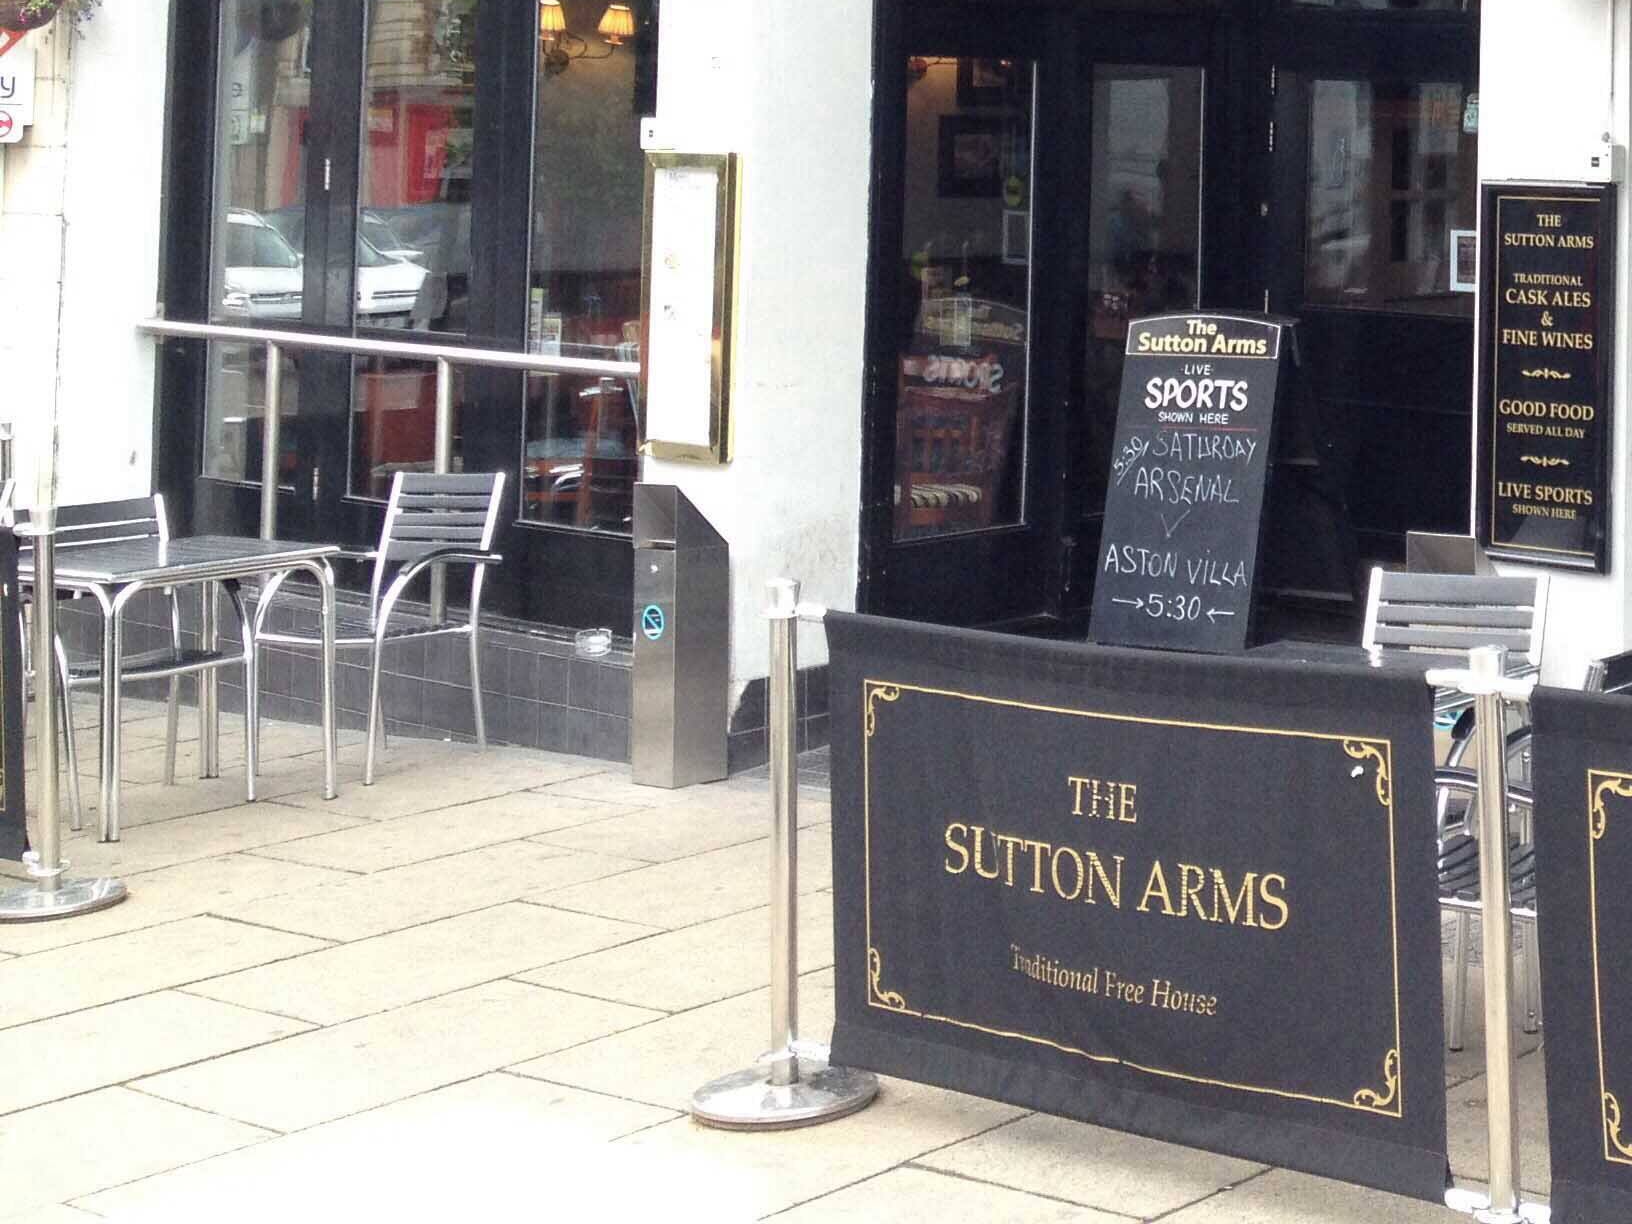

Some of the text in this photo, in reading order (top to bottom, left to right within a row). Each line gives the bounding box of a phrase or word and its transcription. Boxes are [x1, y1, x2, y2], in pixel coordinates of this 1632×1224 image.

[1536, 214, 1562, 227] THE
[1504, 233, 1594, 249] SUTTON ARMS
[1513, 273, 1583, 287] TRADITIONAL
[1505, 288, 1592, 308] CASK ALES
[1187, 320, 1218, 336] The
[1541, 310, 1554, 327] &
[1138, 332, 1267, 355] Sutton Arms
[1502, 328, 1593, 350] FINE WINES
[1184, 364, 1212, 376] LIVE
[1144, 377, 1248, 412] SPORTS
[1158, 411, 1229, 425] SHOWN HERE
[1499, 400, 1595, 421] GOOD FOOD
[1506, 422, 1585, 439] SERVED ALL DAY
[1152, 431, 1257, 465] SATURDAY
[1134, 466, 1241, 505] ARSENAL
[1498, 482, 1593, 505] LIVE SPORTS
[1512, 504, 1577, 520] SHOWN HERE
[1104, 543, 1178, 578] ASTON
[1145, 594, 1201, 620] 5:30
[1068, 776, 1137, 823] THE
[944, 823, 1289, 931] SUTTON ARMS
[1104, 970, 1145, 1005] Free
[1151, 979, 1218, 1016] House
